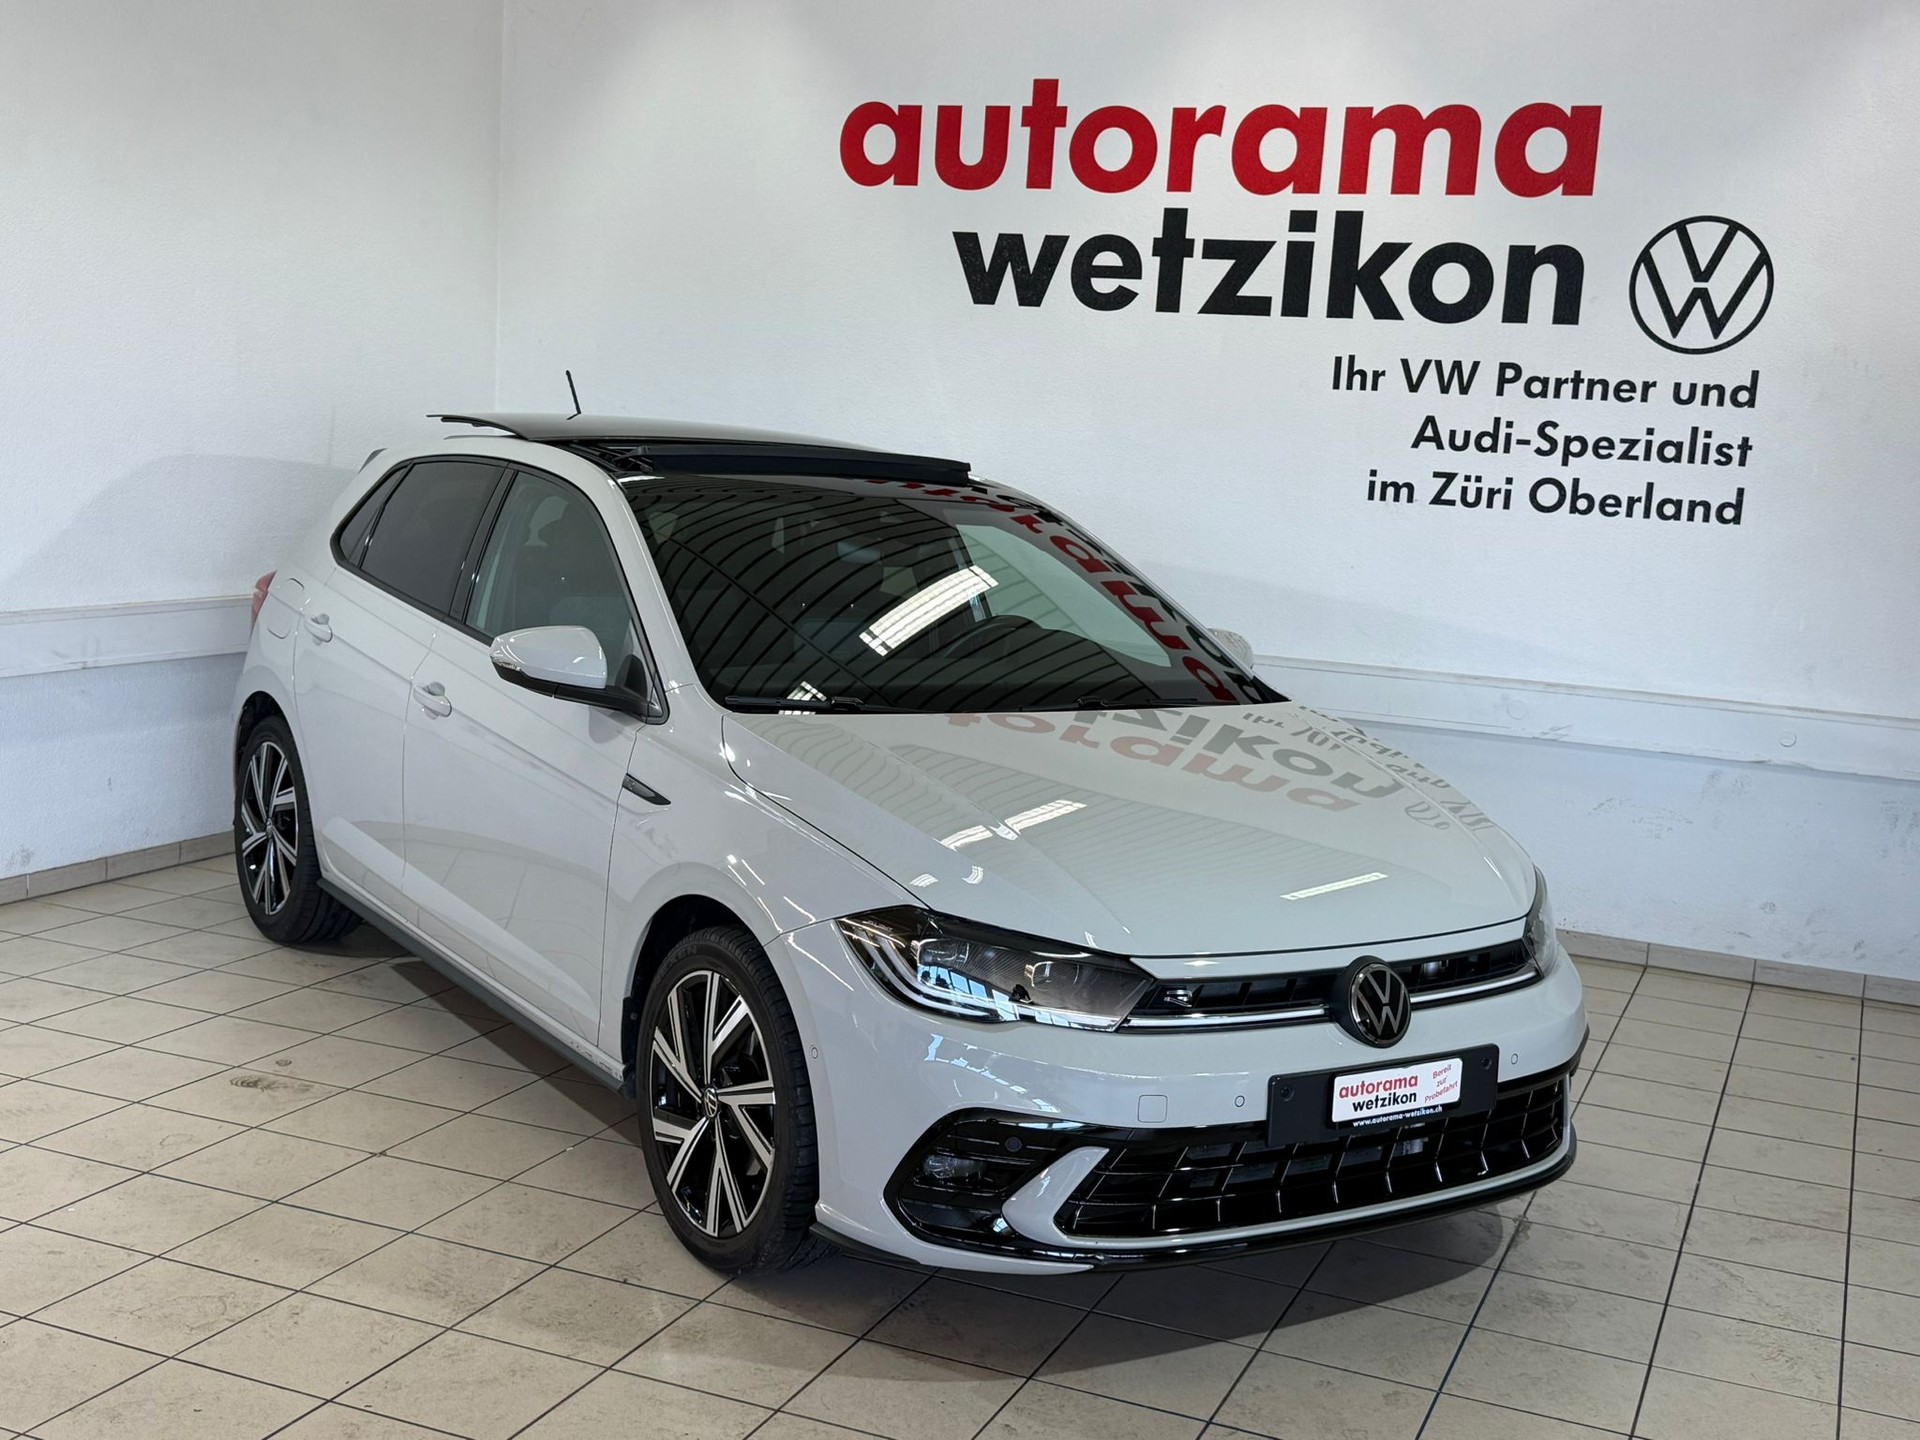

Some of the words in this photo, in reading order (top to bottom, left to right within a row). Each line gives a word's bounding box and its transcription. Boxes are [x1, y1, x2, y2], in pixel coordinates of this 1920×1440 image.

[840, 79, 1602, 198] autorama
[953, 208, 1585, 326] wetzikon
[1332, 354, 1386, 392] Ihr
[1400, 358, 1480, 396] VW
[1495, 361, 1658, 403] Partner
[1672, 369, 1760, 409] und
[1411, 415, 1753, 468] Audi-Spezialist
[1367, 469, 1415, 504] im
[1428, 471, 1513, 510] Züri
[1528, 477, 1745, 526] Oberland
[1339, 1075, 1418, 1099] autorama
[1432, 1064, 1452, 1079] Bereit
[1352, 1092, 1417, 1112] wetzikon
[1424, 1081, 1458, 1103] Probefahrt
[1353, 1106, 1443, 1127] www.autorama-wetzikon.ch
